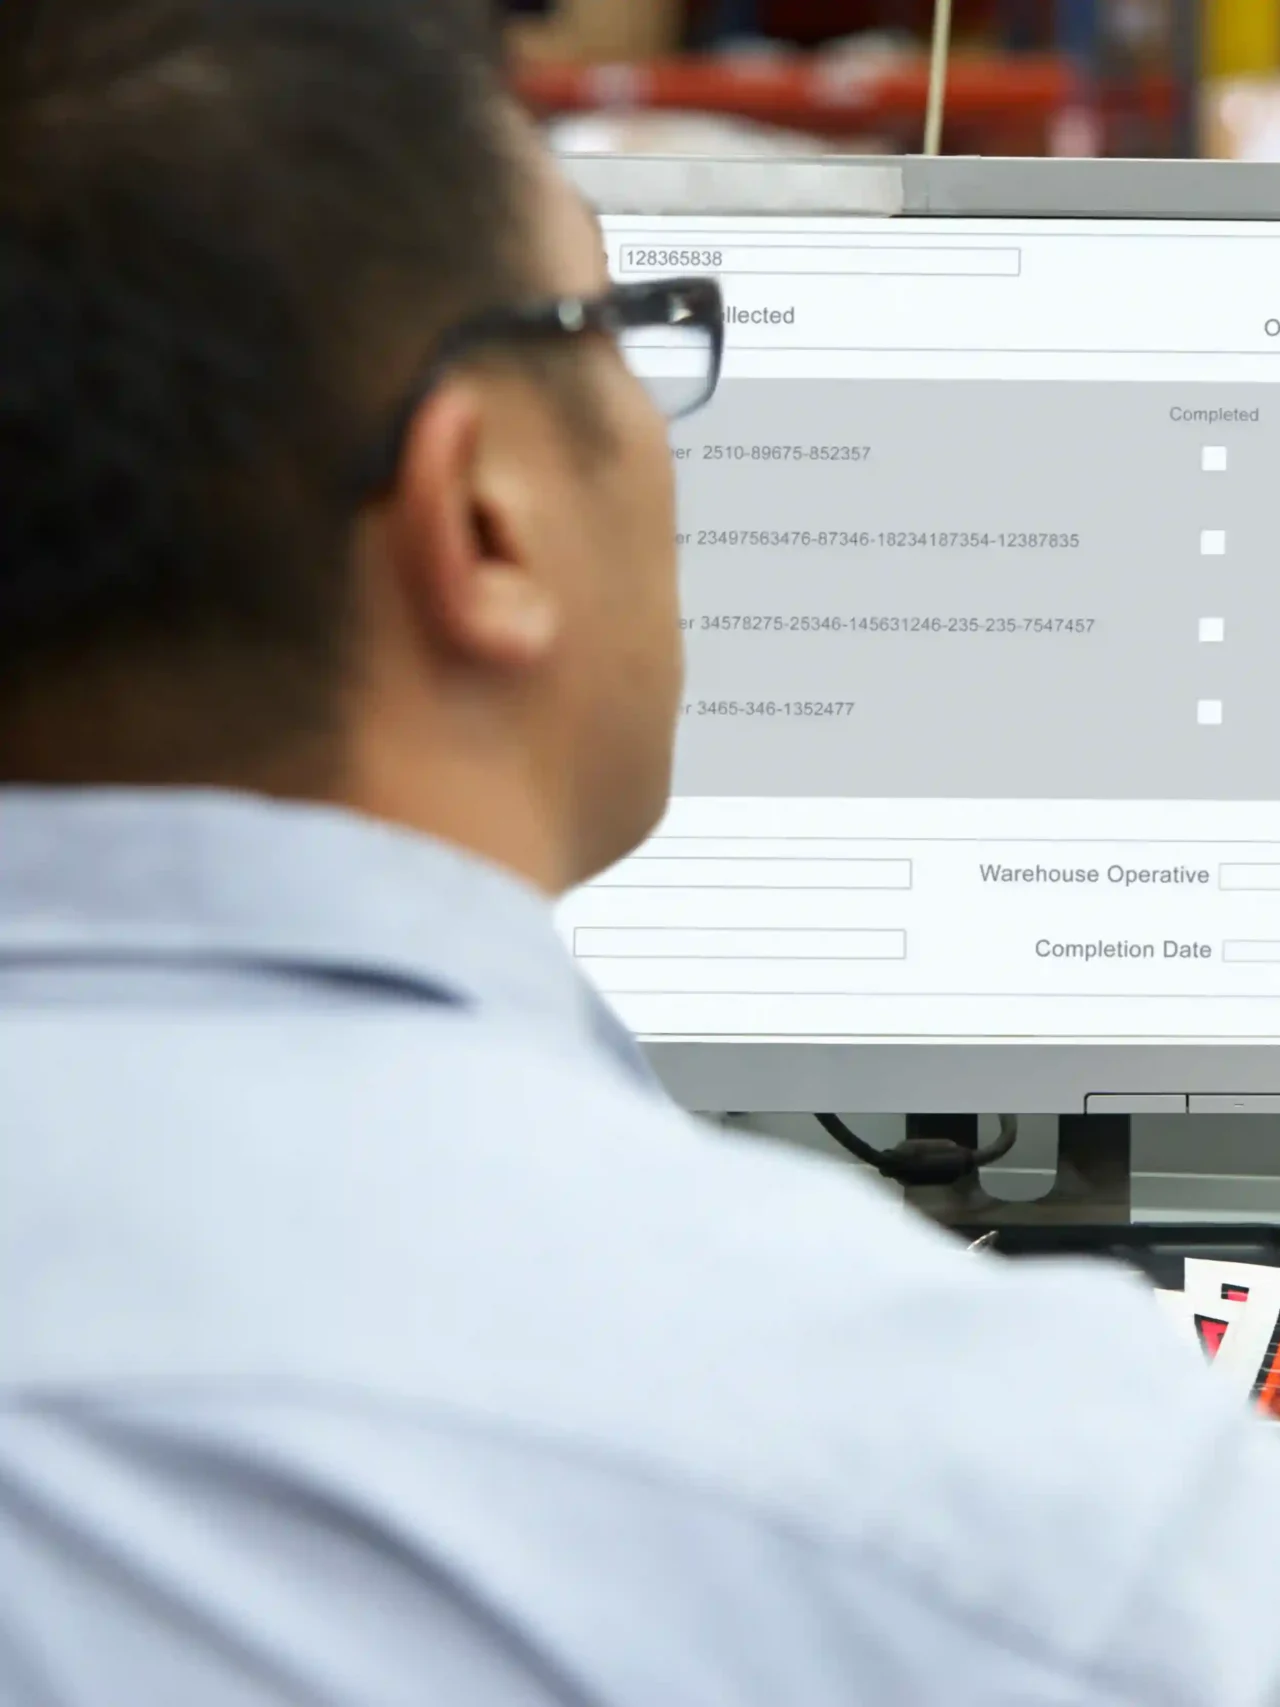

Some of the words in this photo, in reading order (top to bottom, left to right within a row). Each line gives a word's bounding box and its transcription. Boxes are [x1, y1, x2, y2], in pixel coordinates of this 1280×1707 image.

[627, 250, 722, 267] 128365838
[722, 306, 795, 324] llected
[1169, 406, 1260, 424] Completed
[703, 445, 871, 461] 2510-89675-852357
[697, 530, 1080, 548] 23497563476-87346-18234187354-12387835
[701, 616, 1095, 633] 34578275-25346-145631246-235-235-7547457
[697, 701, 855, 717] 3465-346-1352477
[979, 864, 1100, 884] Warehouse
[1106, 864, 1210, 888] Operative
[1034, 939, 1155, 963] Completion
[1162, 940, 1212, 960] Date
